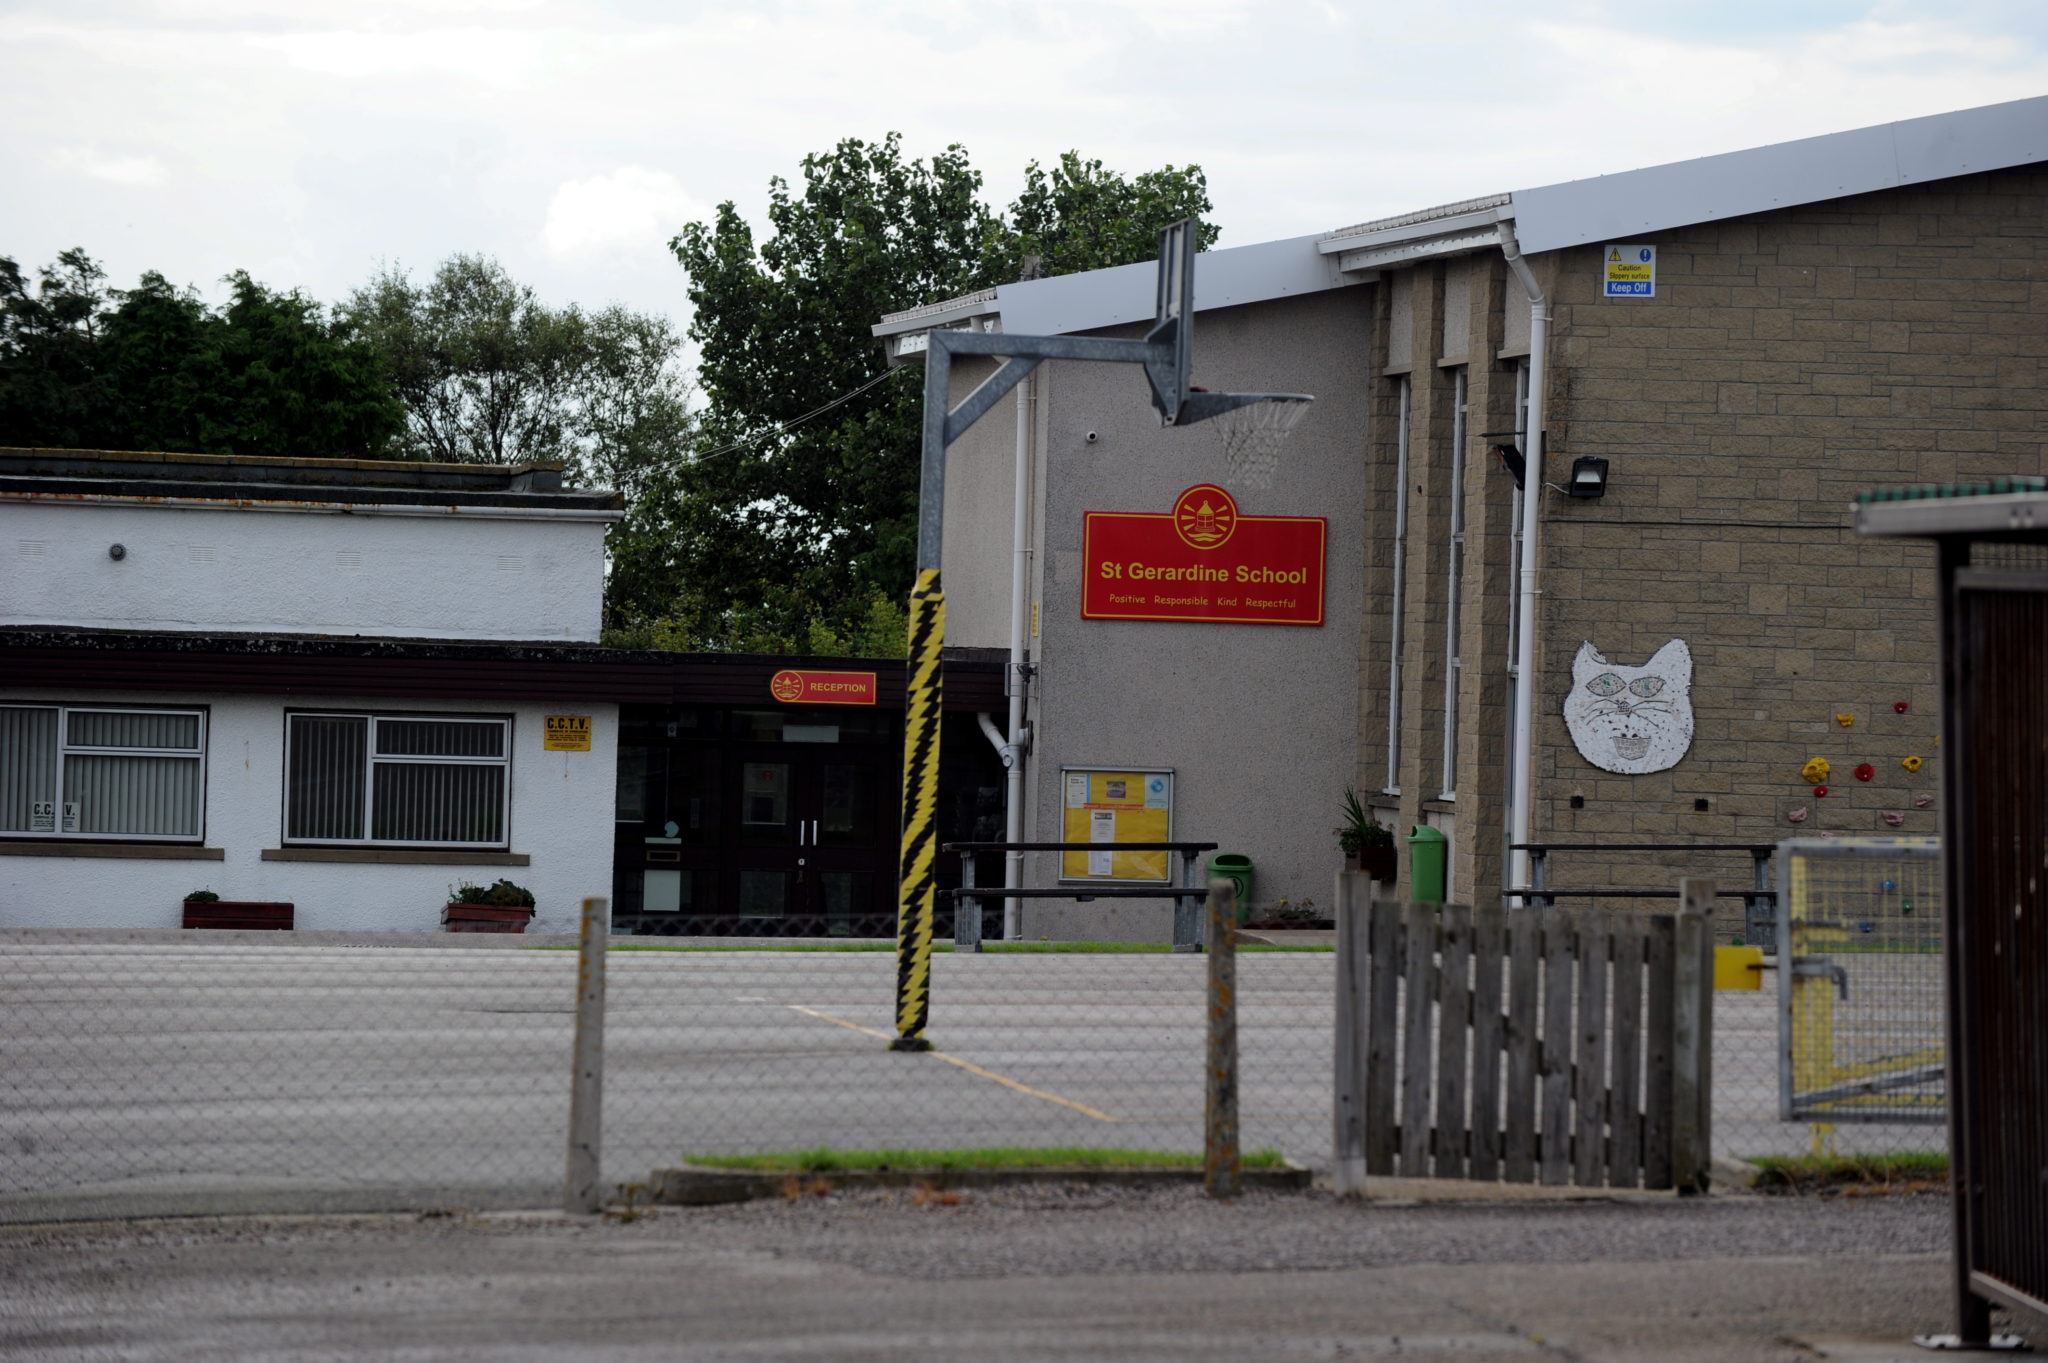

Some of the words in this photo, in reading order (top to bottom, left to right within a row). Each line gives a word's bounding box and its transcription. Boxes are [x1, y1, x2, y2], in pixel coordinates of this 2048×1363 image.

[1618, 264, 1641, 272] Caution
[1611, 282, 1632, 293] Keep
[1634, 283, 1647, 292] Off
[1101, 562, 1122, 579] St
[1128, 562, 1229, 582] Gerardine
[1235, 565, 1308, 584] School
[1109, 593, 1146, 604] Positive
[1154, 595, 1209, 607] Responsible
[1217, 597, 1238, 606] Kind
[1246, 597, 1297, 609] Respectful
[810, 683, 866, 692] RECEPTION
[547, 717, 589, 729] C.C.T.V.
